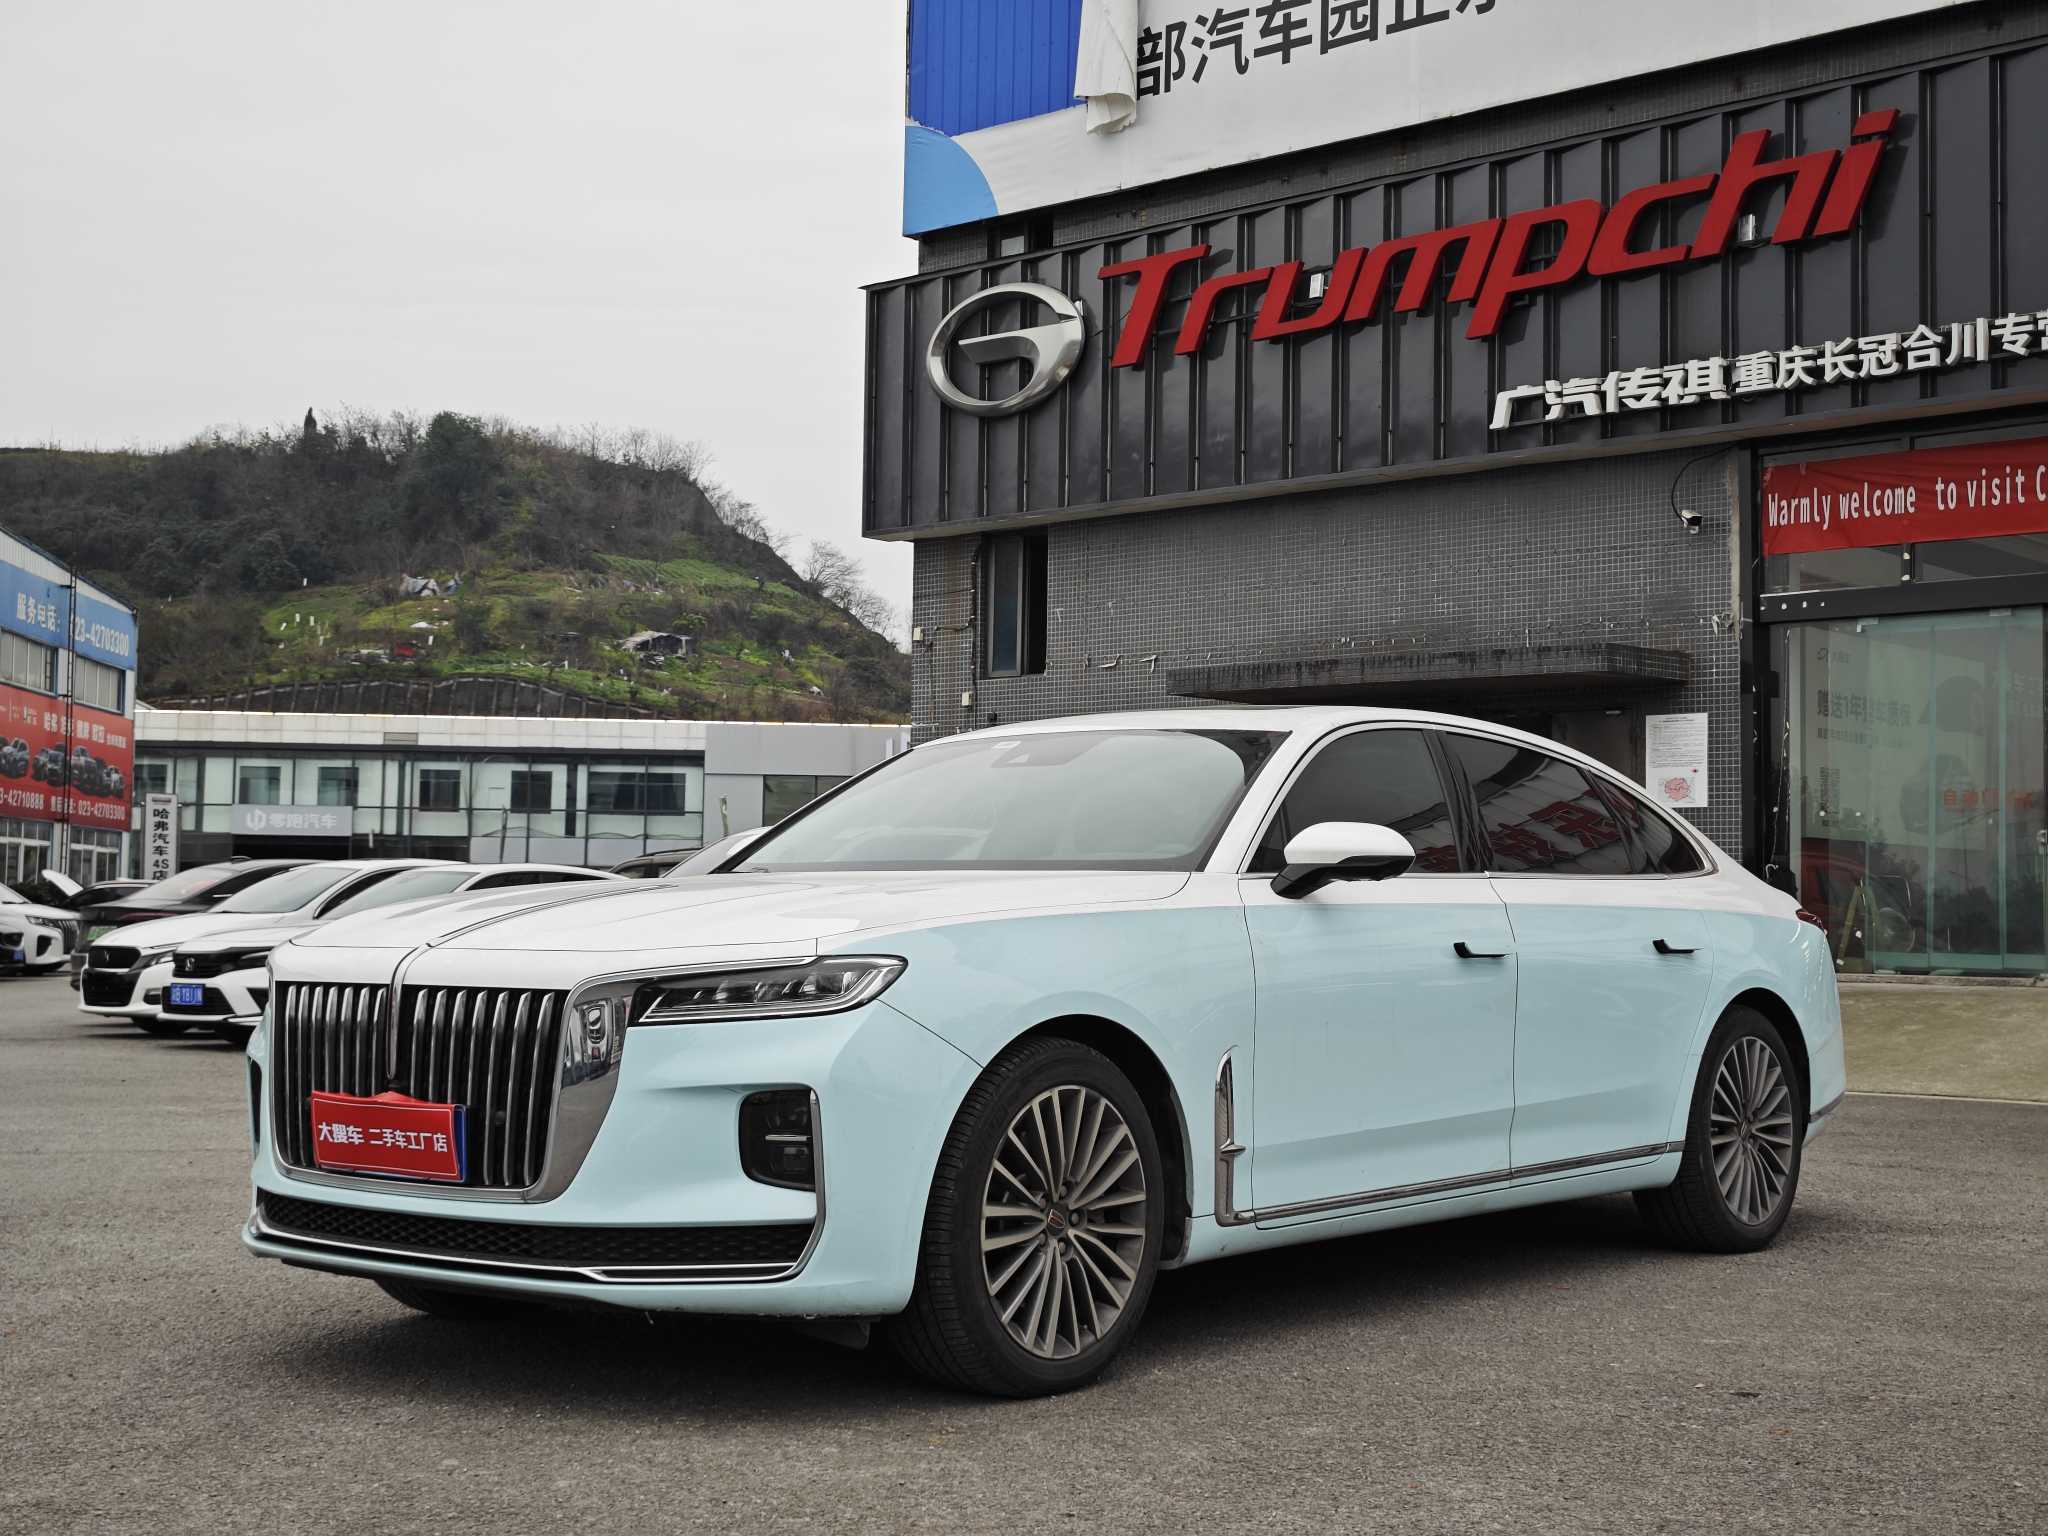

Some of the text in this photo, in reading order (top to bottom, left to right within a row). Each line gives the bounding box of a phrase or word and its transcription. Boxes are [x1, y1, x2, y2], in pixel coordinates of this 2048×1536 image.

[1099, 108, 1899, 367] Trumpchi
[1768, 487, 1831, 530] Warmly
[1839, 481, 1916, 520] welcome
[1935, 476, 1957, 510] to
[1966, 465, 2025, 508] visit
[368, 1128, 448, 1153] 二手车工厂店
